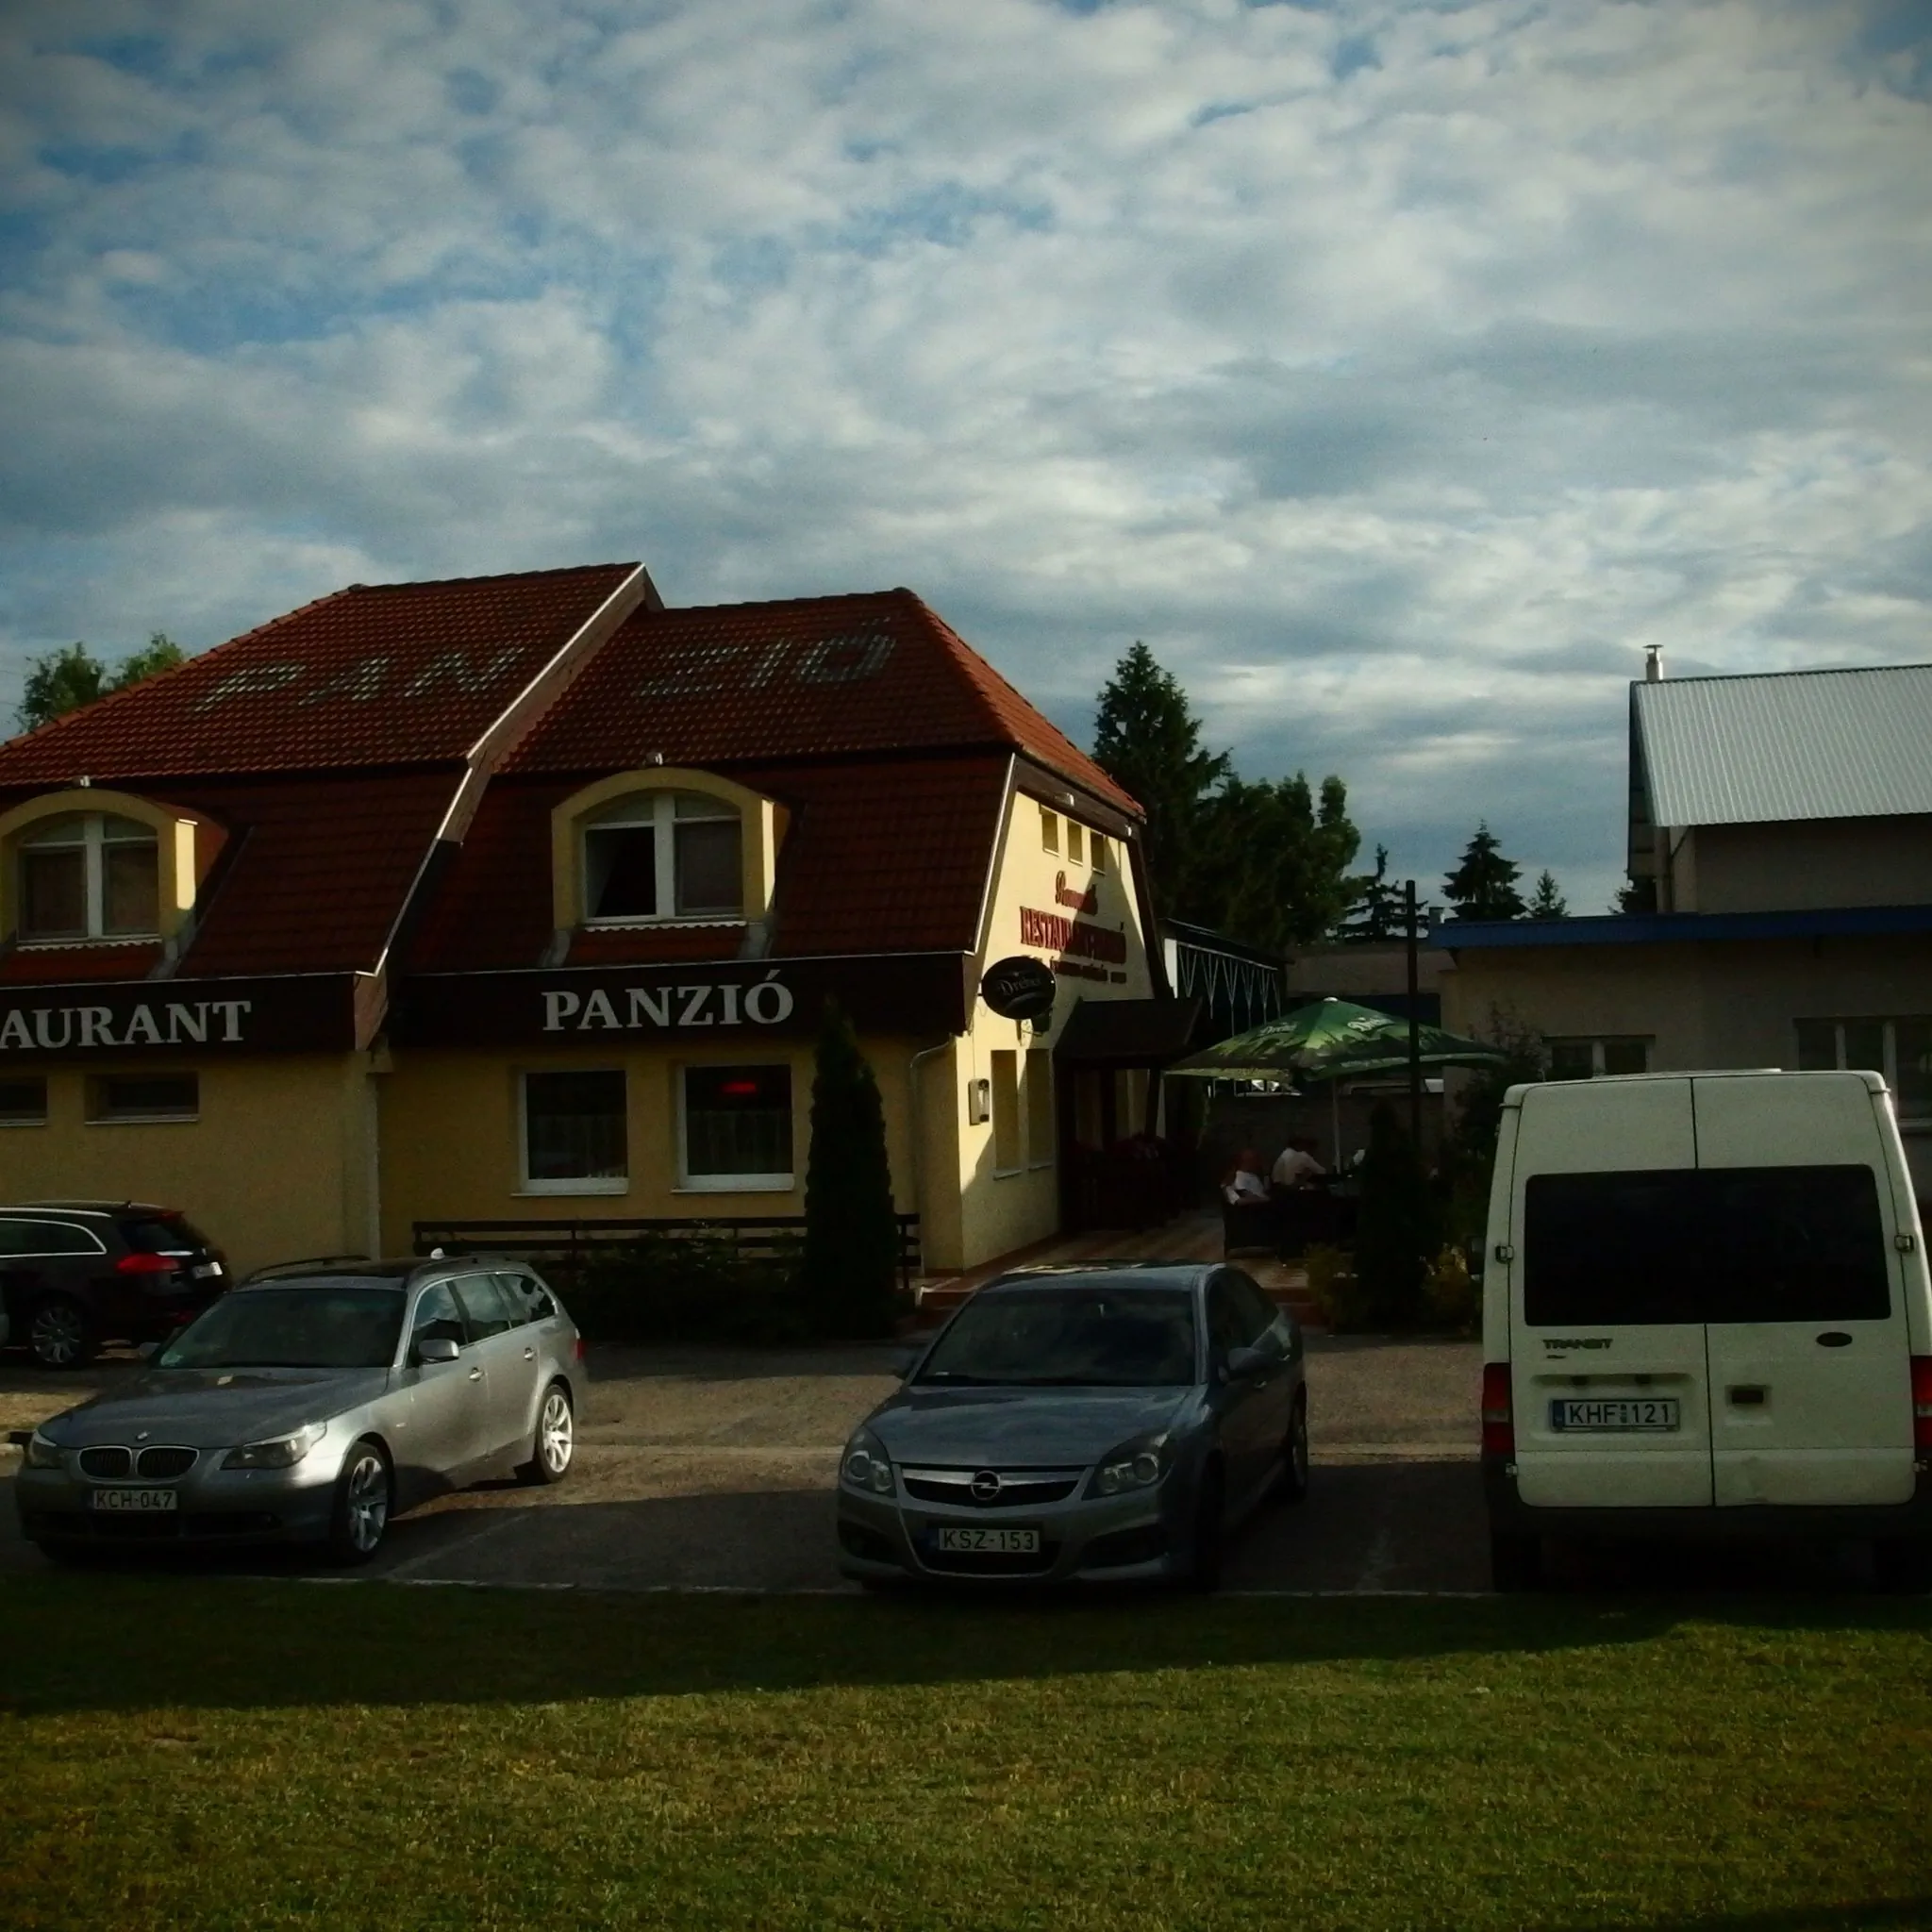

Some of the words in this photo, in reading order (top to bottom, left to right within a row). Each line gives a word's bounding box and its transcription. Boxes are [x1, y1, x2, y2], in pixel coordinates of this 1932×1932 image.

[541, 969, 794, 1031] PANZIÓ
[0, 1000, 253, 1049] AURANT
[96, 1491, 172, 1508] KCH-047
[944, 1529, 1034, 1550] KSZ-153
